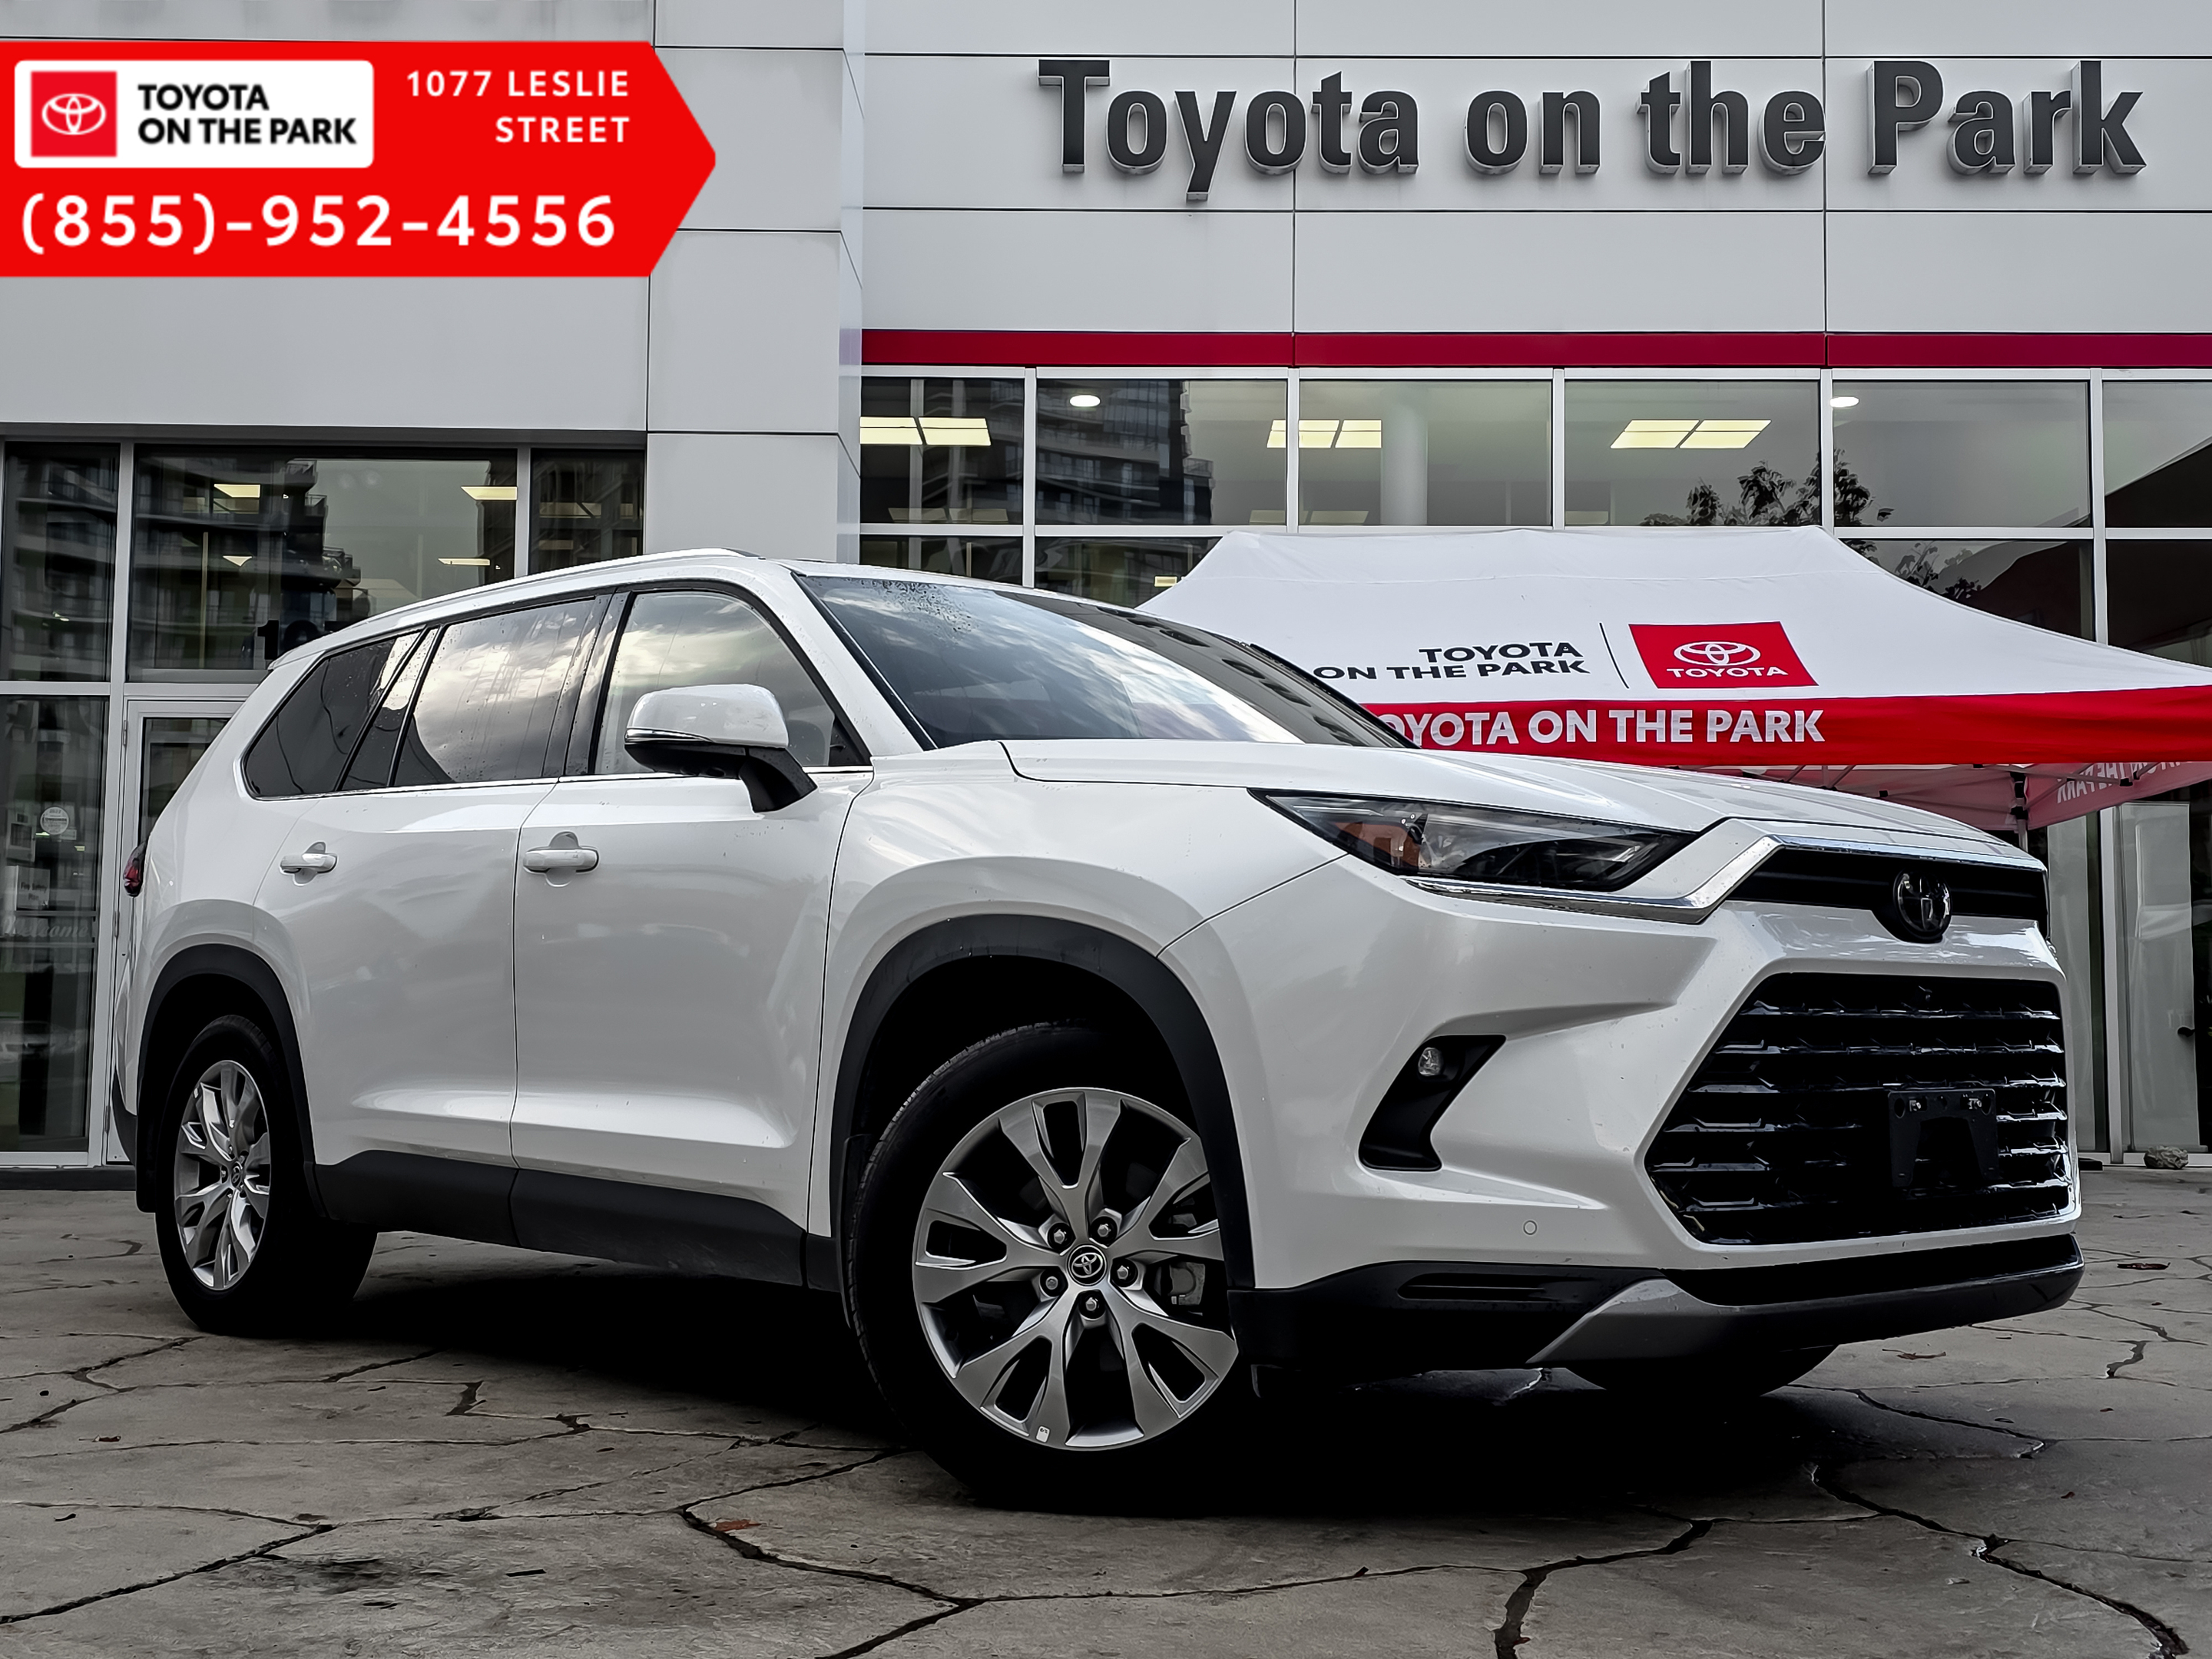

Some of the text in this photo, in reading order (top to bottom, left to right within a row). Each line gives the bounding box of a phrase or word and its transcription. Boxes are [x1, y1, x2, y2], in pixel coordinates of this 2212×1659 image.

[1037, 59, 2147, 200] Toyota on the Park
[1419, 642, 1584, 663] TOYOTA
[1313, 659, 1591, 680] ON THE PARK
[1666, 666, 1789, 677] TOYOTA
[1378, 710, 1825, 746] YOTA ON THE PARK
